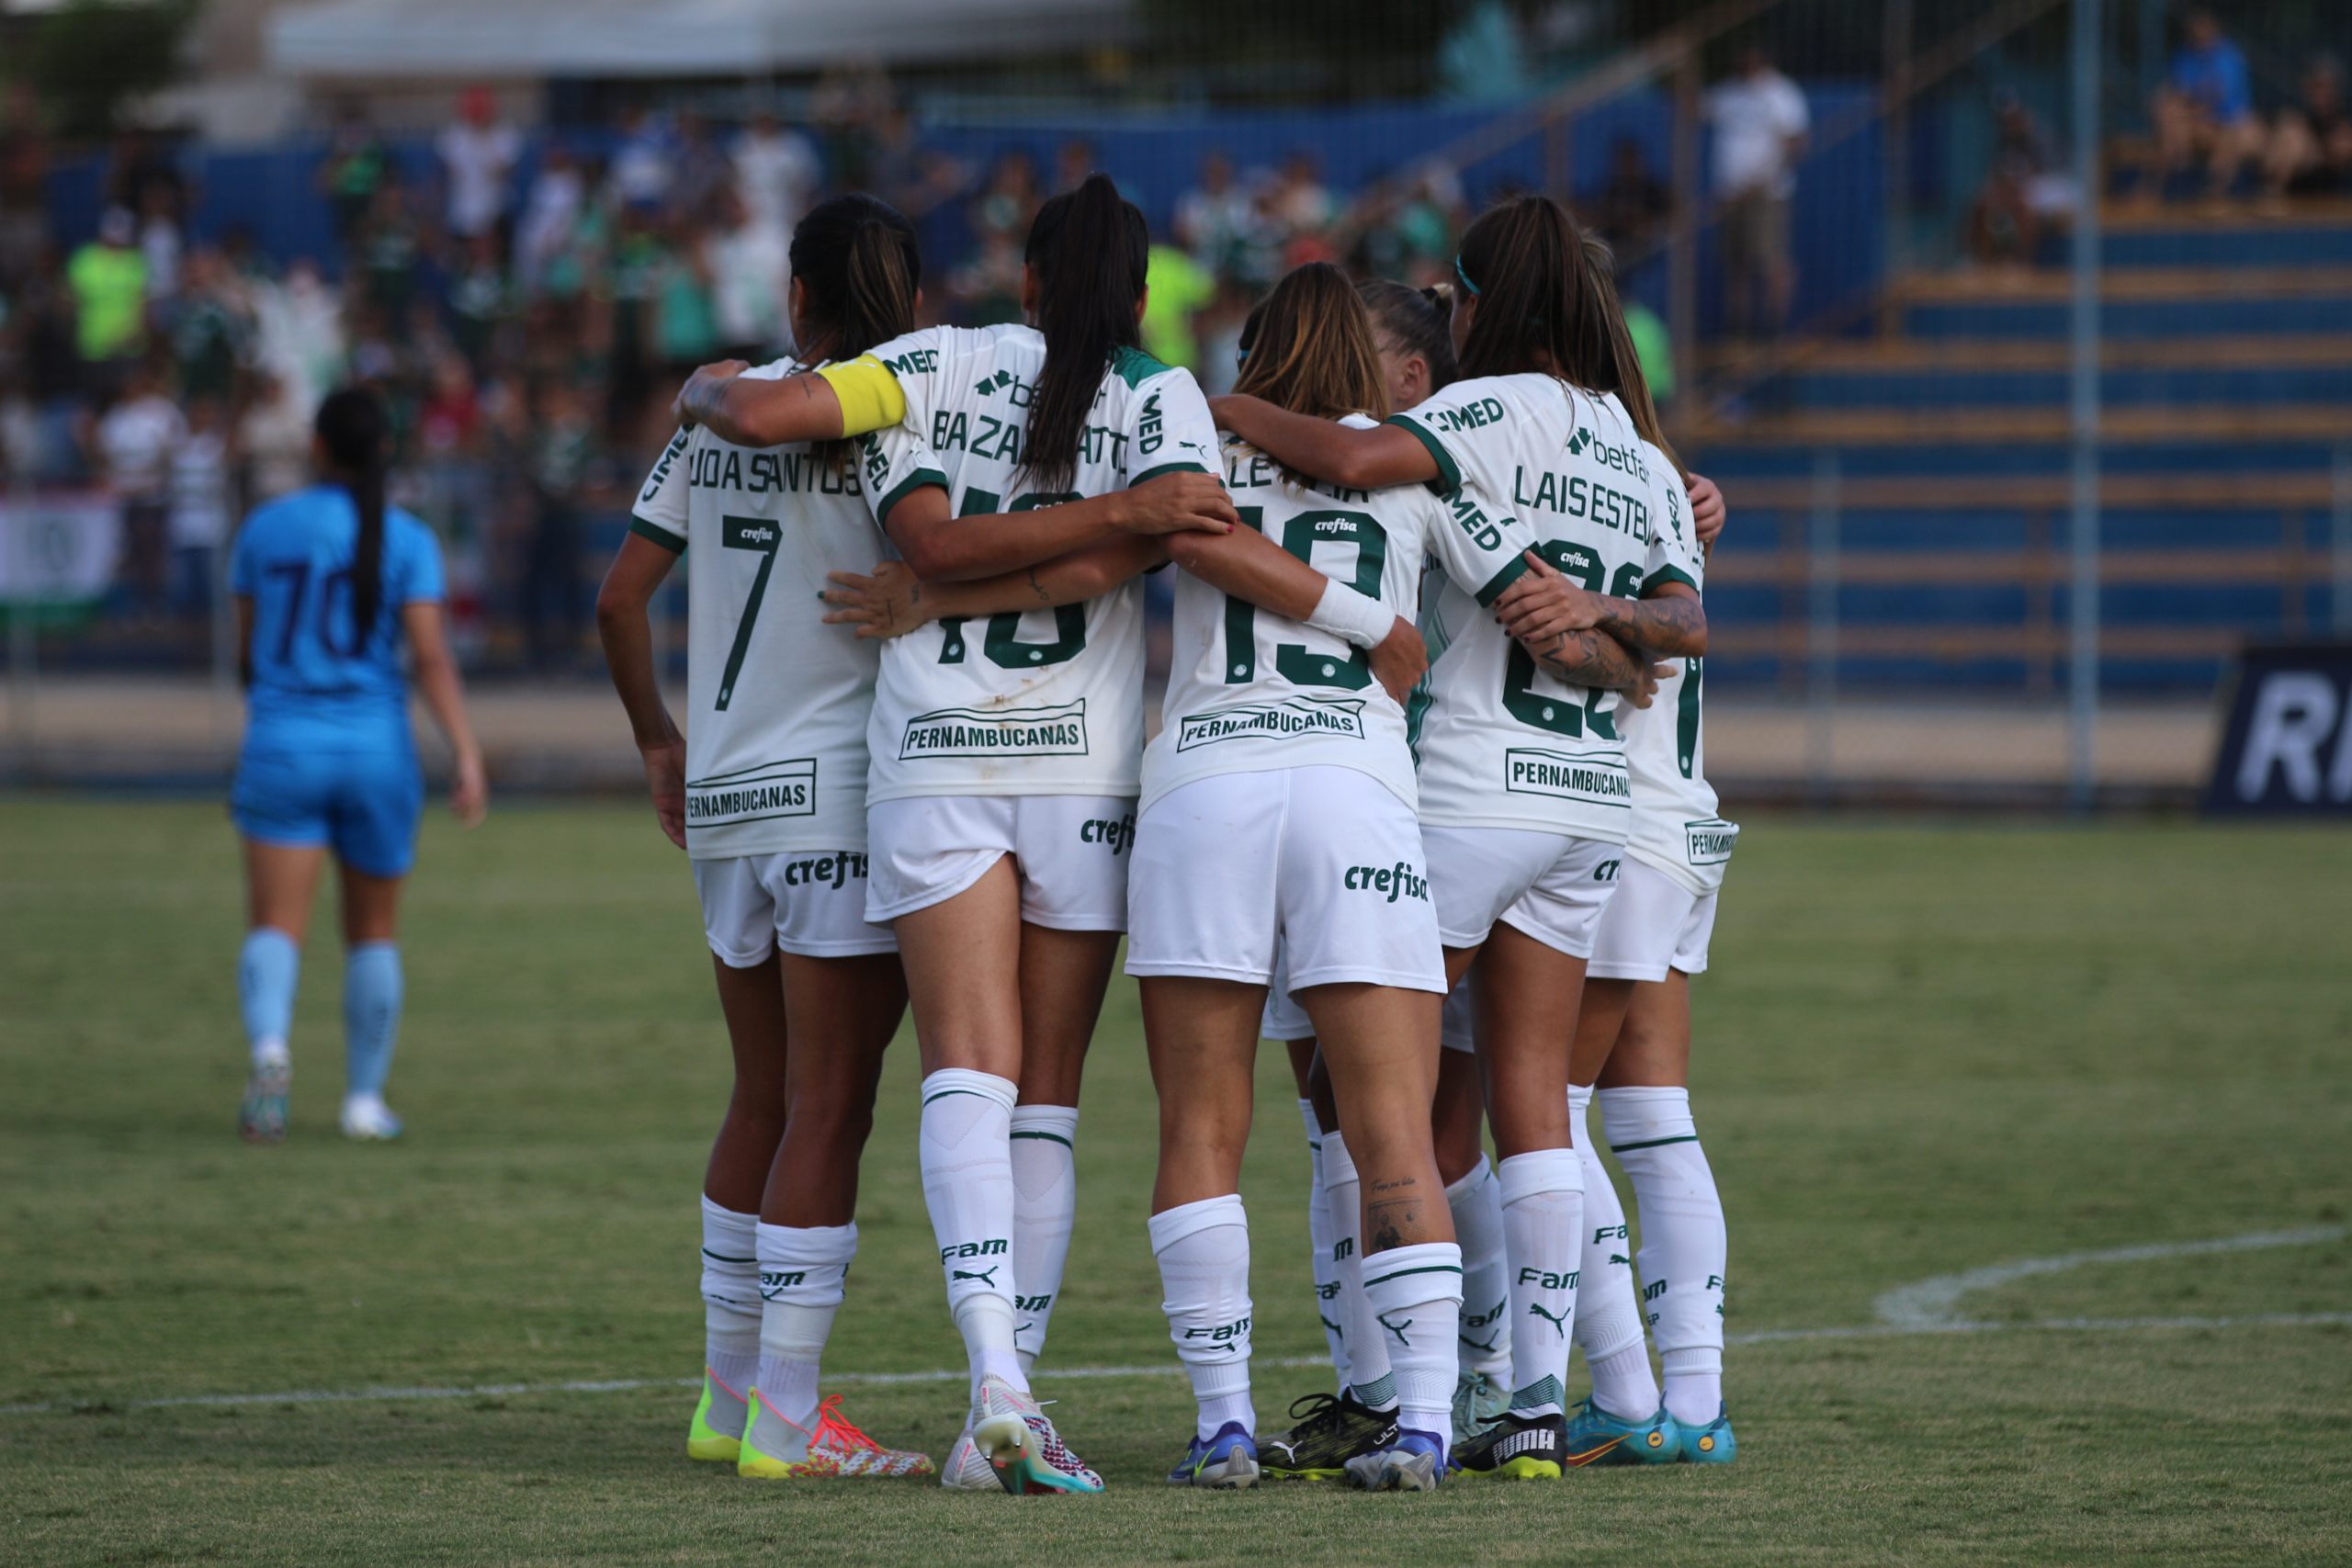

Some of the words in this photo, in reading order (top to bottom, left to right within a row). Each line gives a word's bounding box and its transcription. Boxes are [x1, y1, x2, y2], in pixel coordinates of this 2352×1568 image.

[1314, 517, 1358, 534] crefisa
[714, 514, 783, 712] 7
[906, 723, 1080, 750] PERNAMBUCANAS
[1184, 710, 1354, 743] PERNAMBUCANAS
[942, 1238, 1008, 1266] Fam
[1492, 1427, 1556, 1468] PUMA
